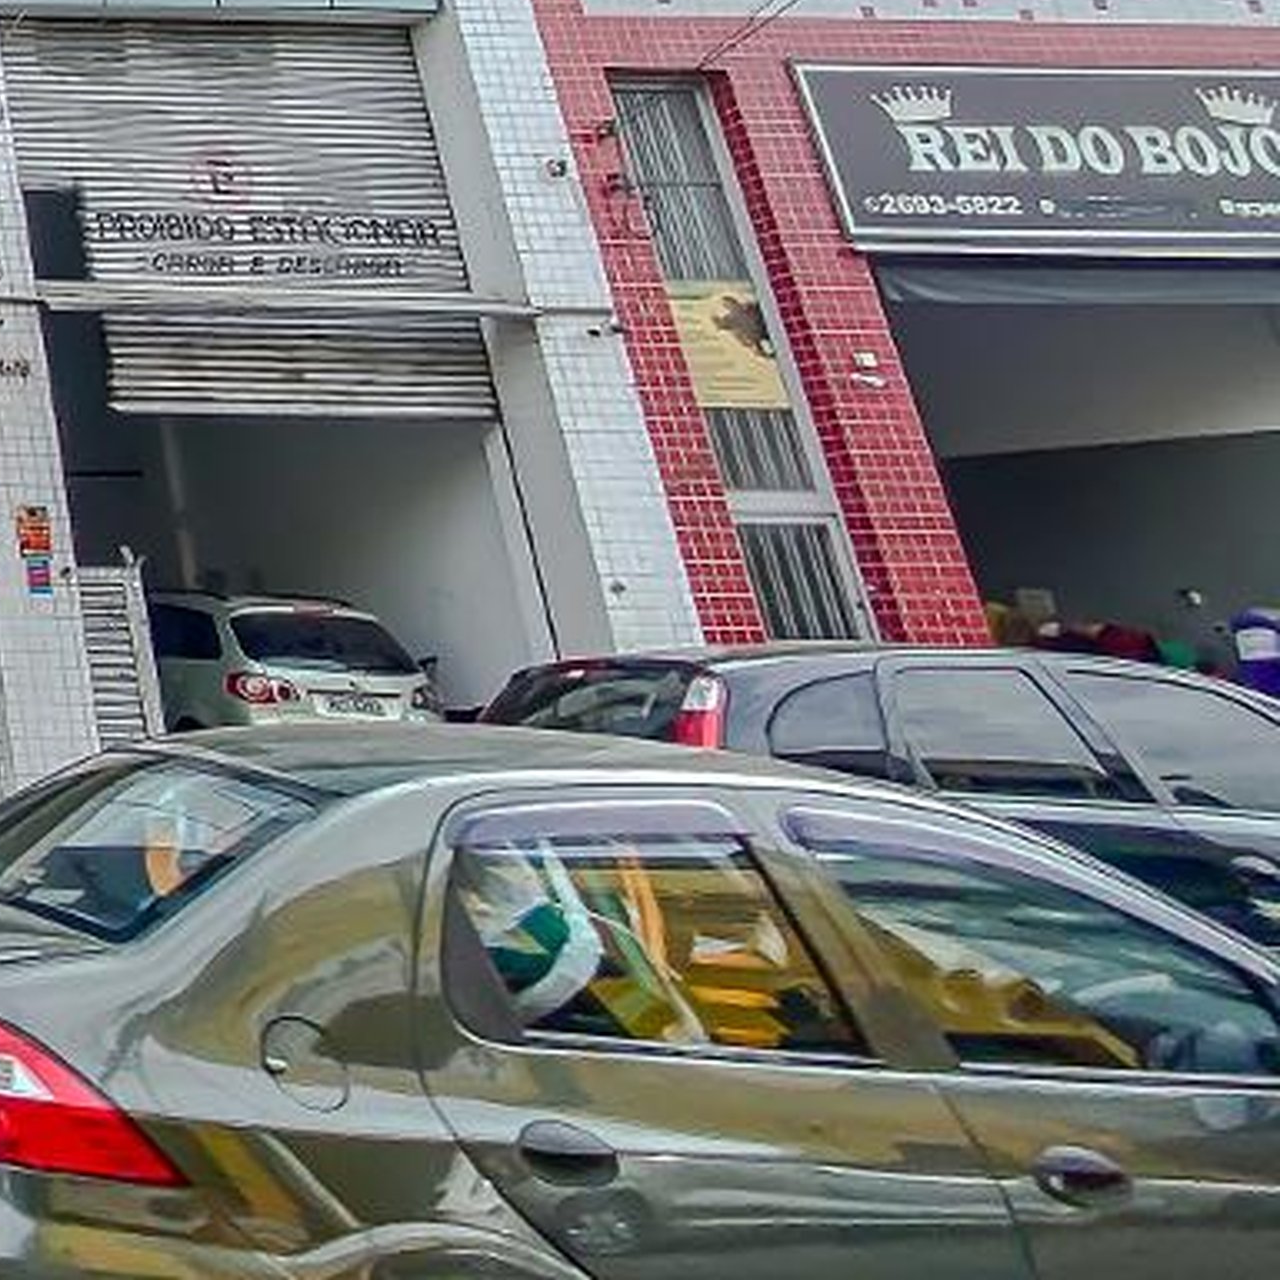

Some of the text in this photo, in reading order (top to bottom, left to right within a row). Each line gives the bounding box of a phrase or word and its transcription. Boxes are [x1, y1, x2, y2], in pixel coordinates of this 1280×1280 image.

[897, 125, 1028, 172] REI
[1027, 125, 1125, 174] DO
[95, 212, 235, 242] PROIBIDO
